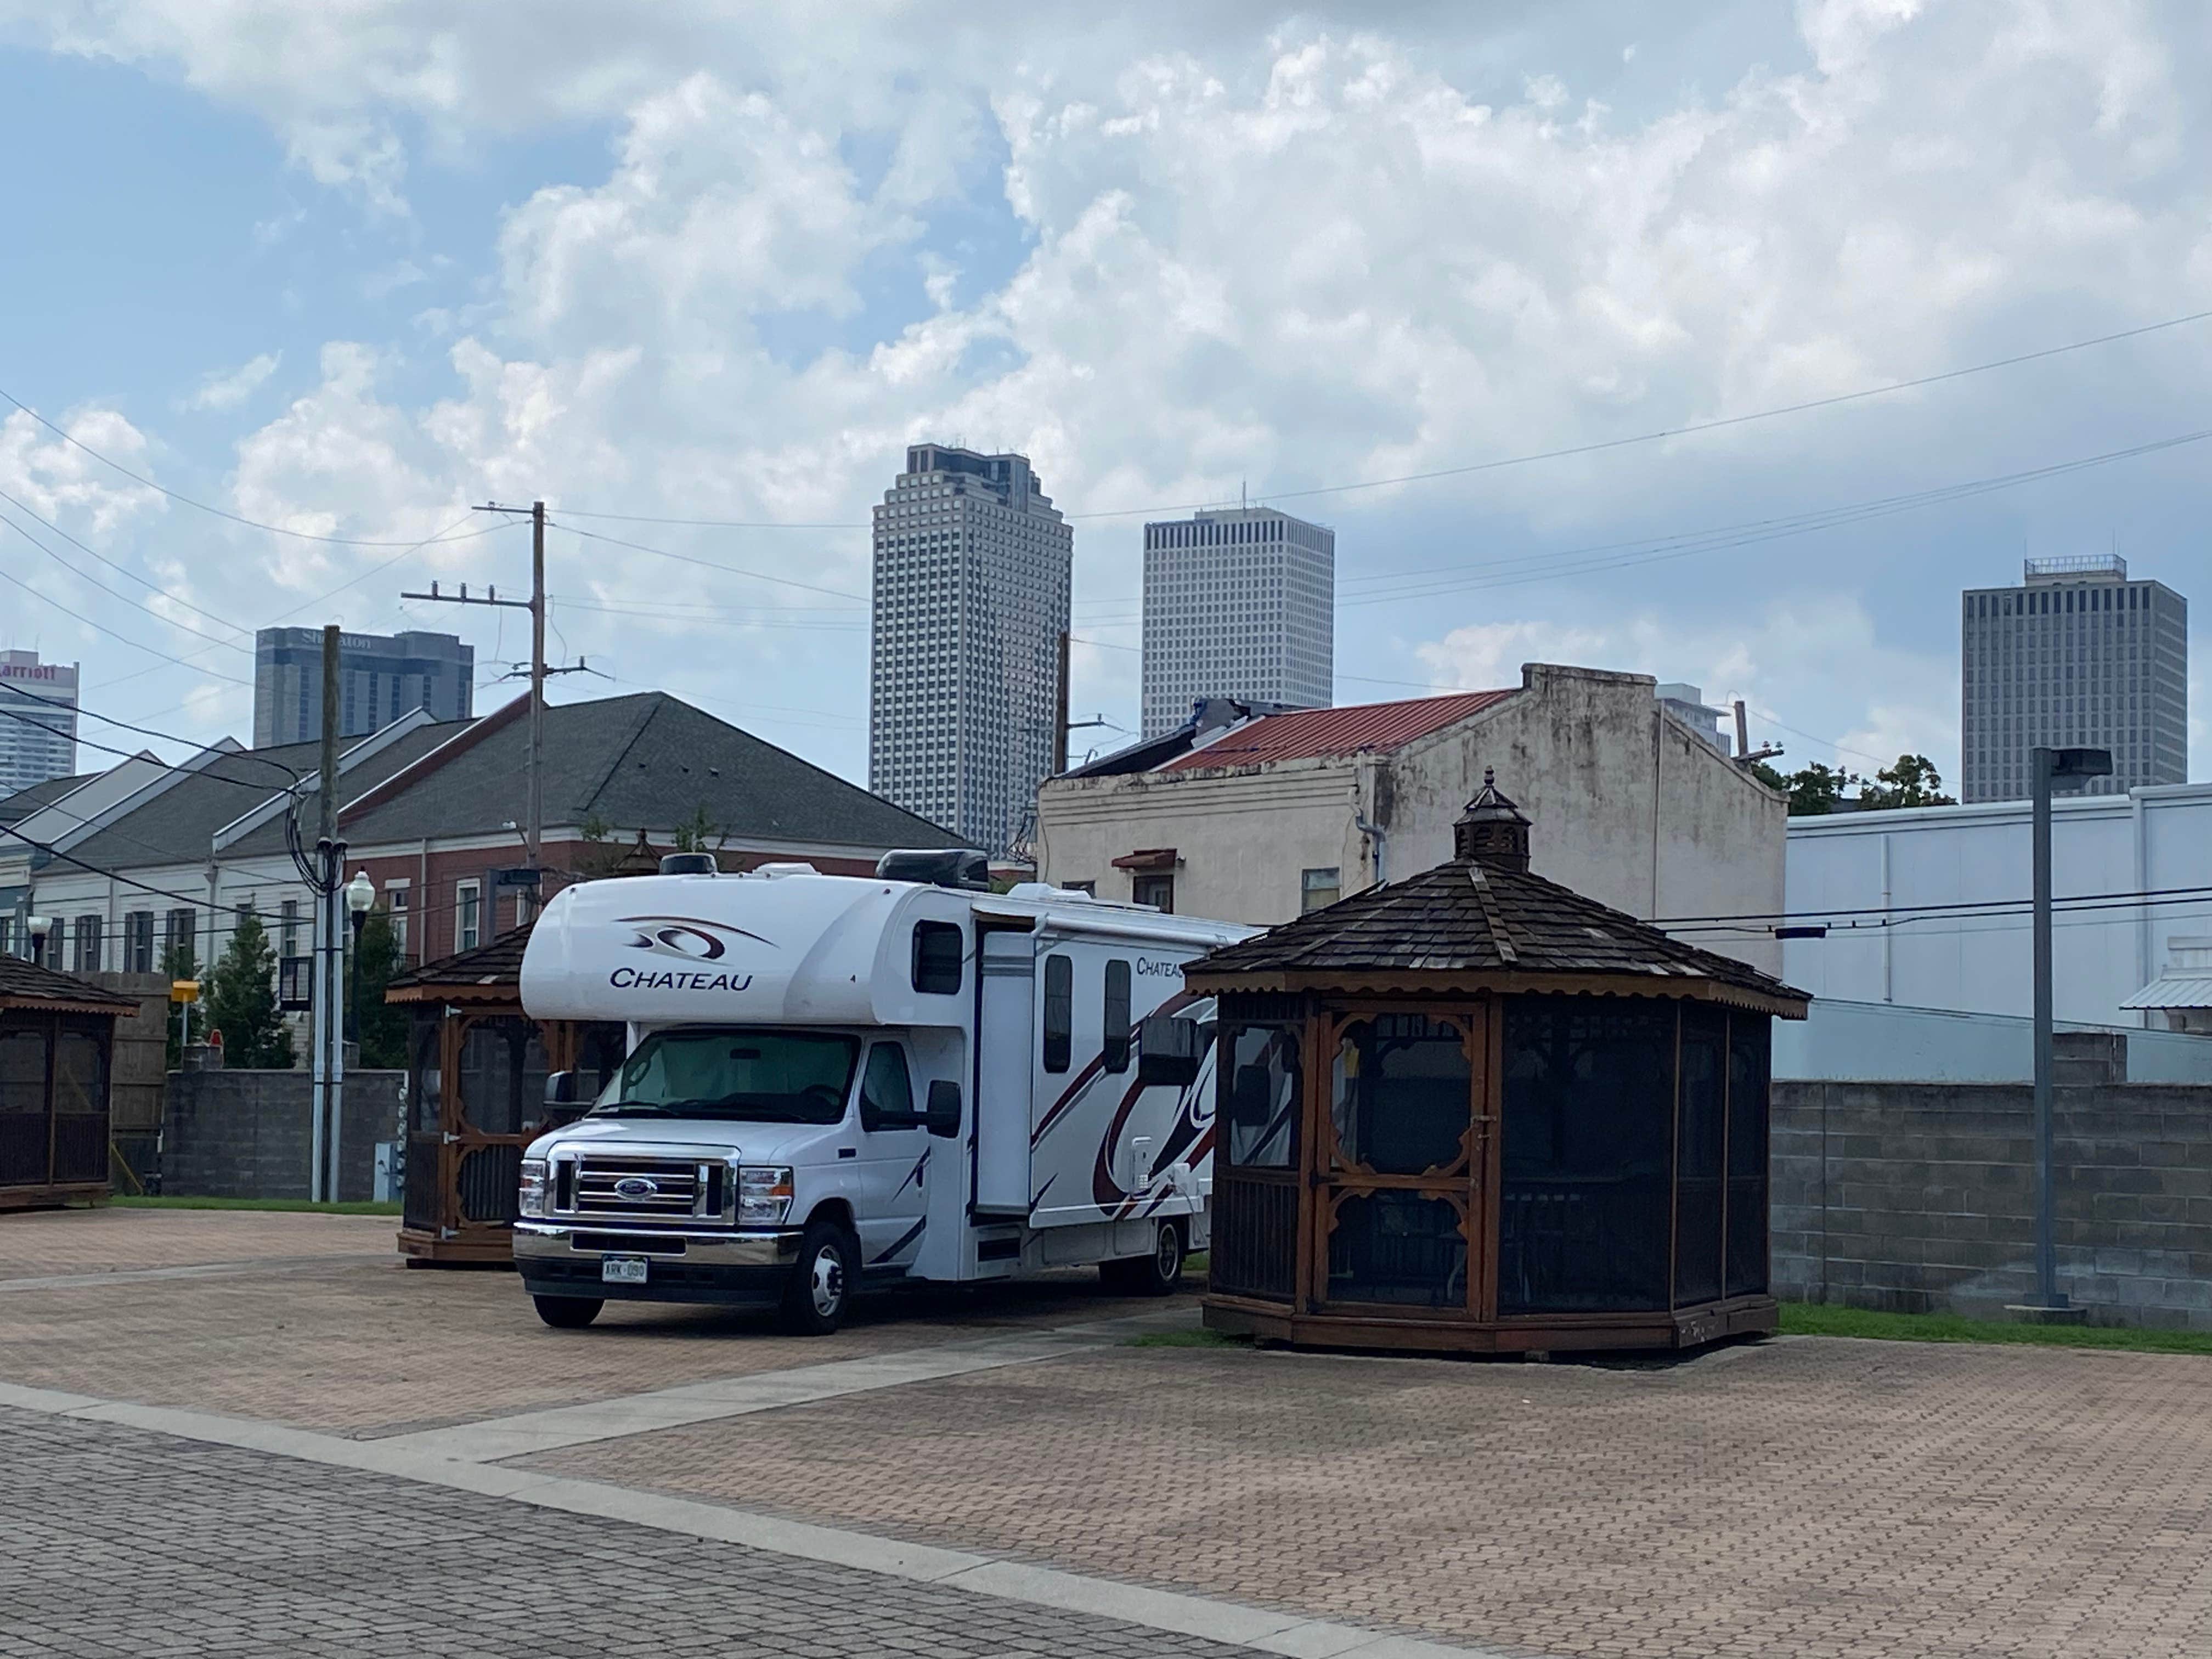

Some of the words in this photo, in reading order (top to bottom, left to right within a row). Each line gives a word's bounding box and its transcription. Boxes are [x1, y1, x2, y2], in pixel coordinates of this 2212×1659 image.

[302, 630, 371, 649] Shaton
[0, 665, 55, 680] arriott
[610, 967, 753, 991] CHATEAU
